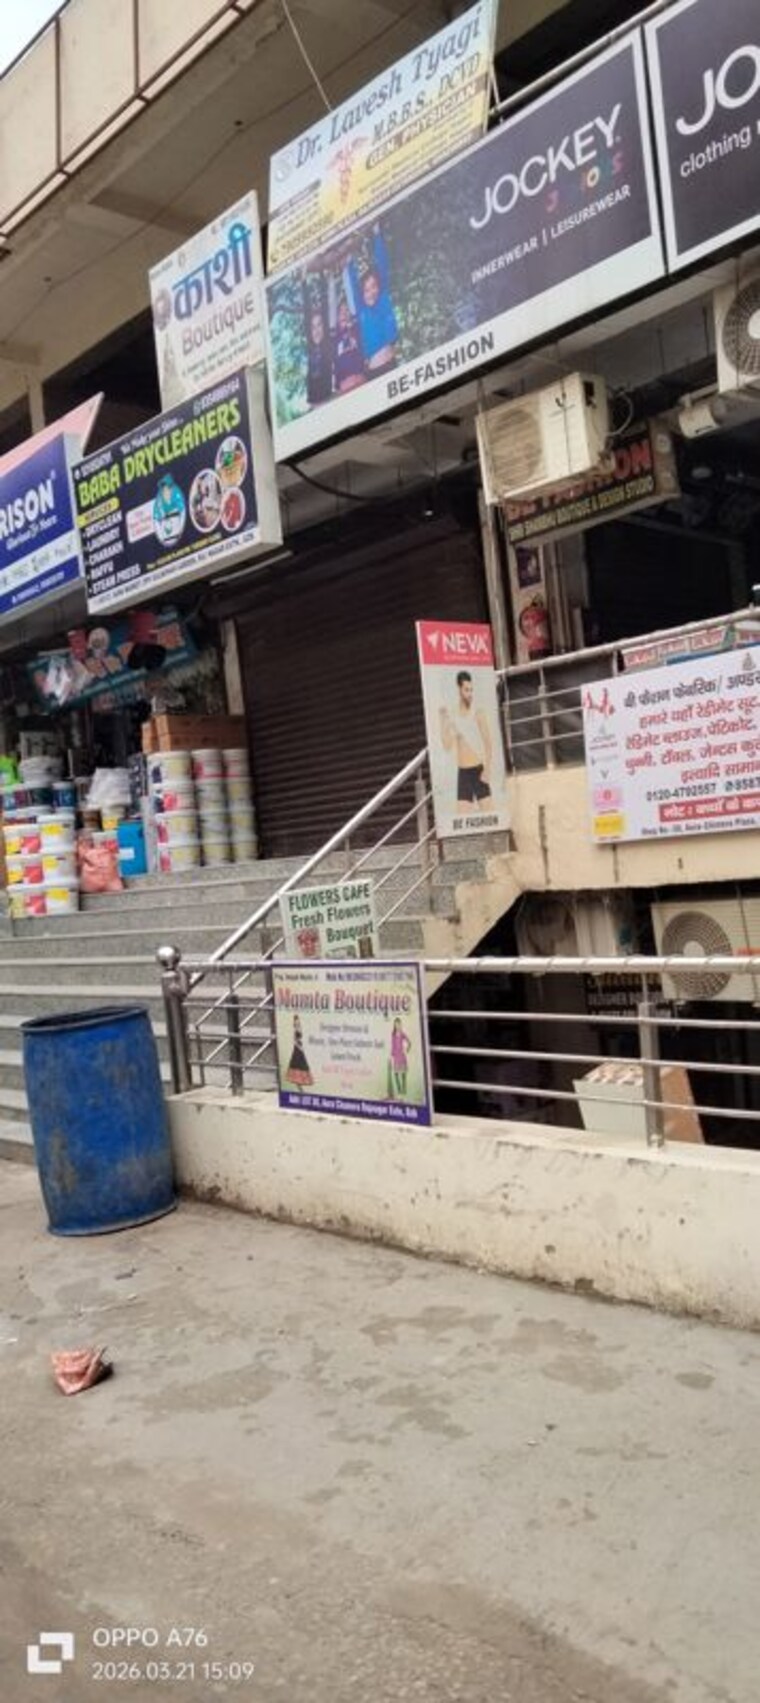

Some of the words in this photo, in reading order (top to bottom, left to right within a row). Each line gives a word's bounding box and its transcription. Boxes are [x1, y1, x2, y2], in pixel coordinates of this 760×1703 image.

[295, 135, 322, 168] Dr.
[329, 70, 402, 144] Lavesh
[412, 6, 482, 83] Tyagi
[402, 83, 476, 142] PHYSICIAN
[470, 103, 622, 229] JOCKEY
[680, 125, 752, 177] clothing
[471, 237, 538, 284] INNERWEAR
[551, 184, 631, 239] LEISUREWEAR
[172, 222, 252, 321] काशी
[182, 294, 254, 355] Boutique
[387, 332, 494, 399] BE-FASHION
[78, 463, 122, 507] BABA
[123, 399, 241, 483] DRYCLEANERS
[626, 474, 655, 499] STUDIO
[442, 632, 489, 654] NEVA
[288, 888, 341, 912] FLOWERS
[342, 883, 371, 902] CAFE
[291, 911, 325, 929] Fresh
[327, 904, 371, 922] Flowers
[276, 986, 330, 1012] Mamta
[333, 988, 411, 1019] Boutique
